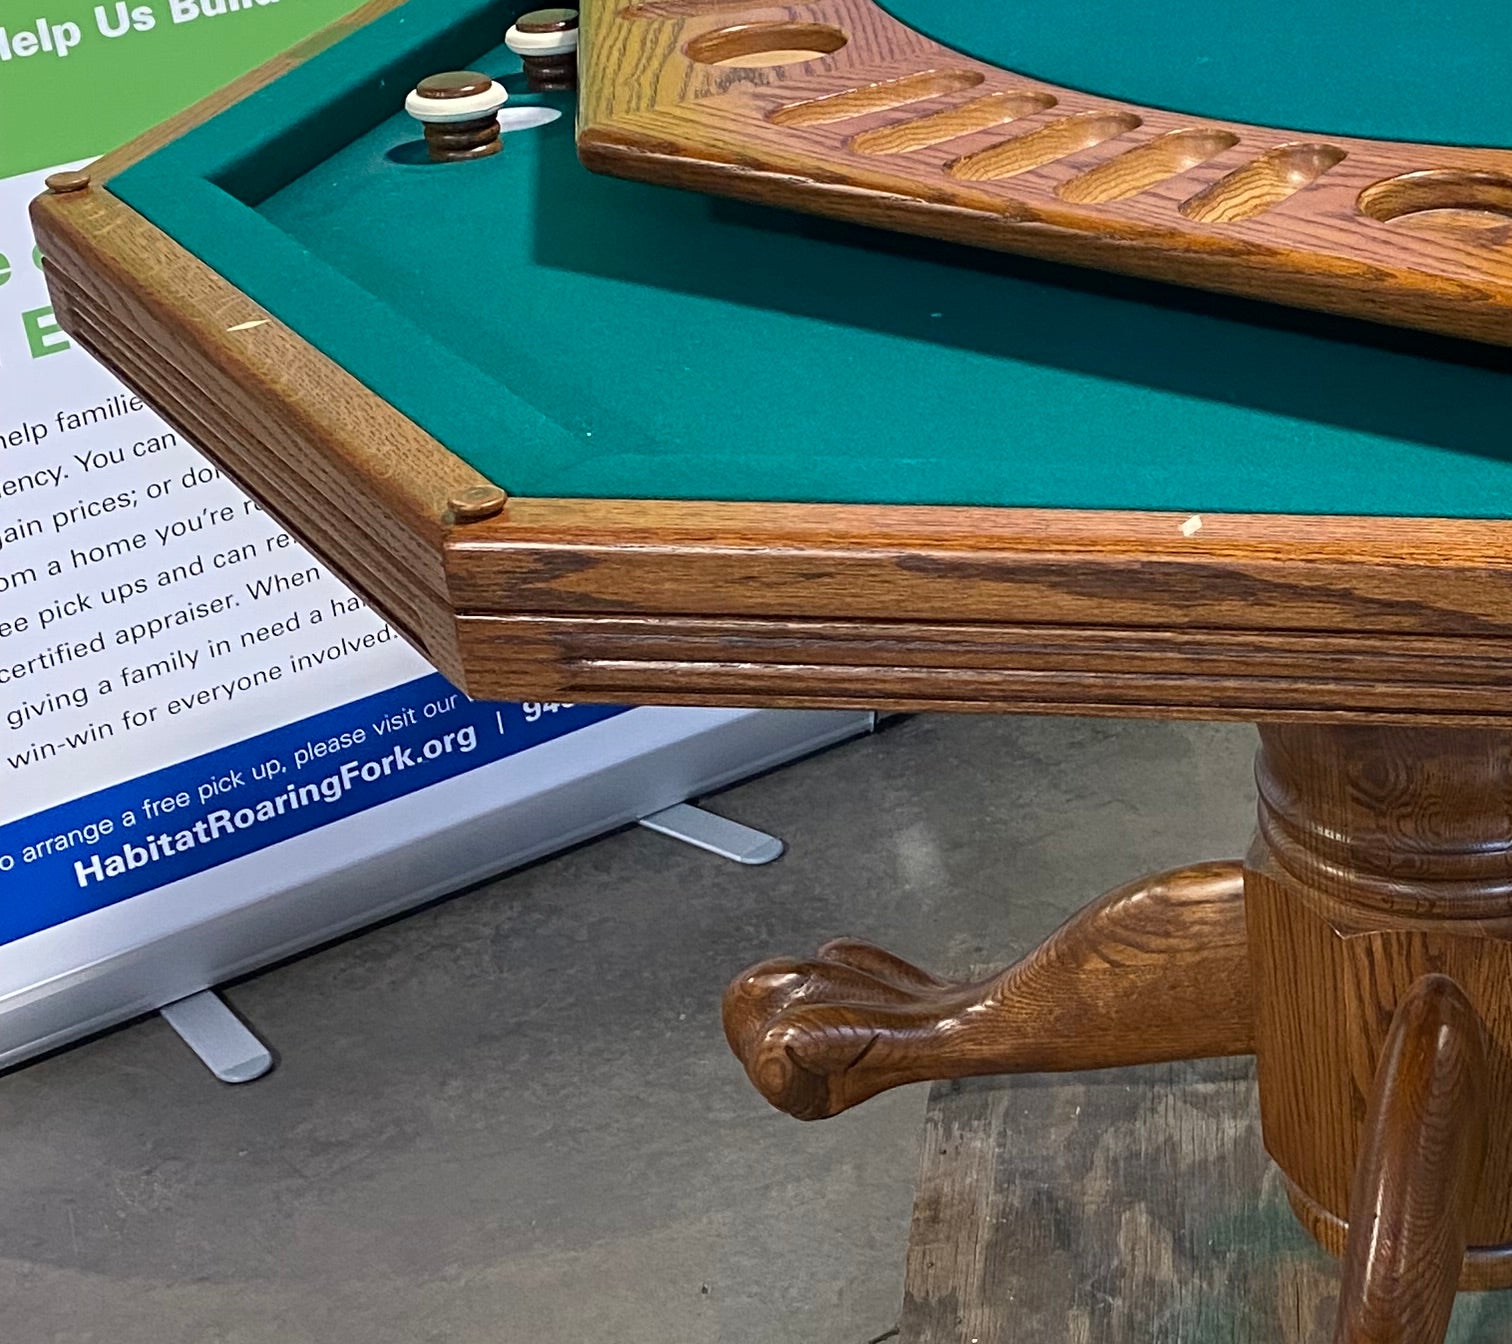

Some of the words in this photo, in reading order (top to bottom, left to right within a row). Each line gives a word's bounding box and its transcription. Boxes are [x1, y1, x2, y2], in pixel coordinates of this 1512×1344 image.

[94, 0, 157, 39] Us
[55, 394, 145, 433] familie
[0, 465, 69, 499] ency.
[74, 447, 126, 473] You
[132, 432, 178, 457] can
[0, 518, 44, 552] ain
[52, 489, 138, 532] prices;
[146, 478, 173, 499] or
[47, 559, 63, 577] a
[70, 533, 148, 569] home
[155, 506, 235, 546] you're
[0, 630, 107, 684] certified
[115, 594, 241, 644] appraiser.
[246, 565, 321, 601] When
[38, 592, 94, 630] pick
[101, 577, 149, 605] ups
[157, 555, 205, 587] and
[213, 542, 258, 569] can
[266, 532, 297, 553] re
[7, 686, 89, 730] giving
[98, 678, 113, 696] a
[120, 648, 200, 688] family
[208, 638, 232, 658] in
[240, 611, 302, 648] need
[309, 607, 324, 625] a
[329, 595, 368, 618] ha
[7, 721, 114, 770] win-win
[121, 705, 158, 731] for
[167, 663, 284, 716] everyone
[289, 622, 400, 674] involved.
[22, 817, 115, 864] arrange
[121, 810, 137, 828] a
[142, 790, 192, 820] free
[197, 769, 246, 805] pick
[251, 756, 287, 781] up,
[294, 726, 367, 769] please
[372, 707, 418, 737] visit
[423, 693, 460, 719] our
[73, 725, 478, 888] HabitatRoaringFork.org
